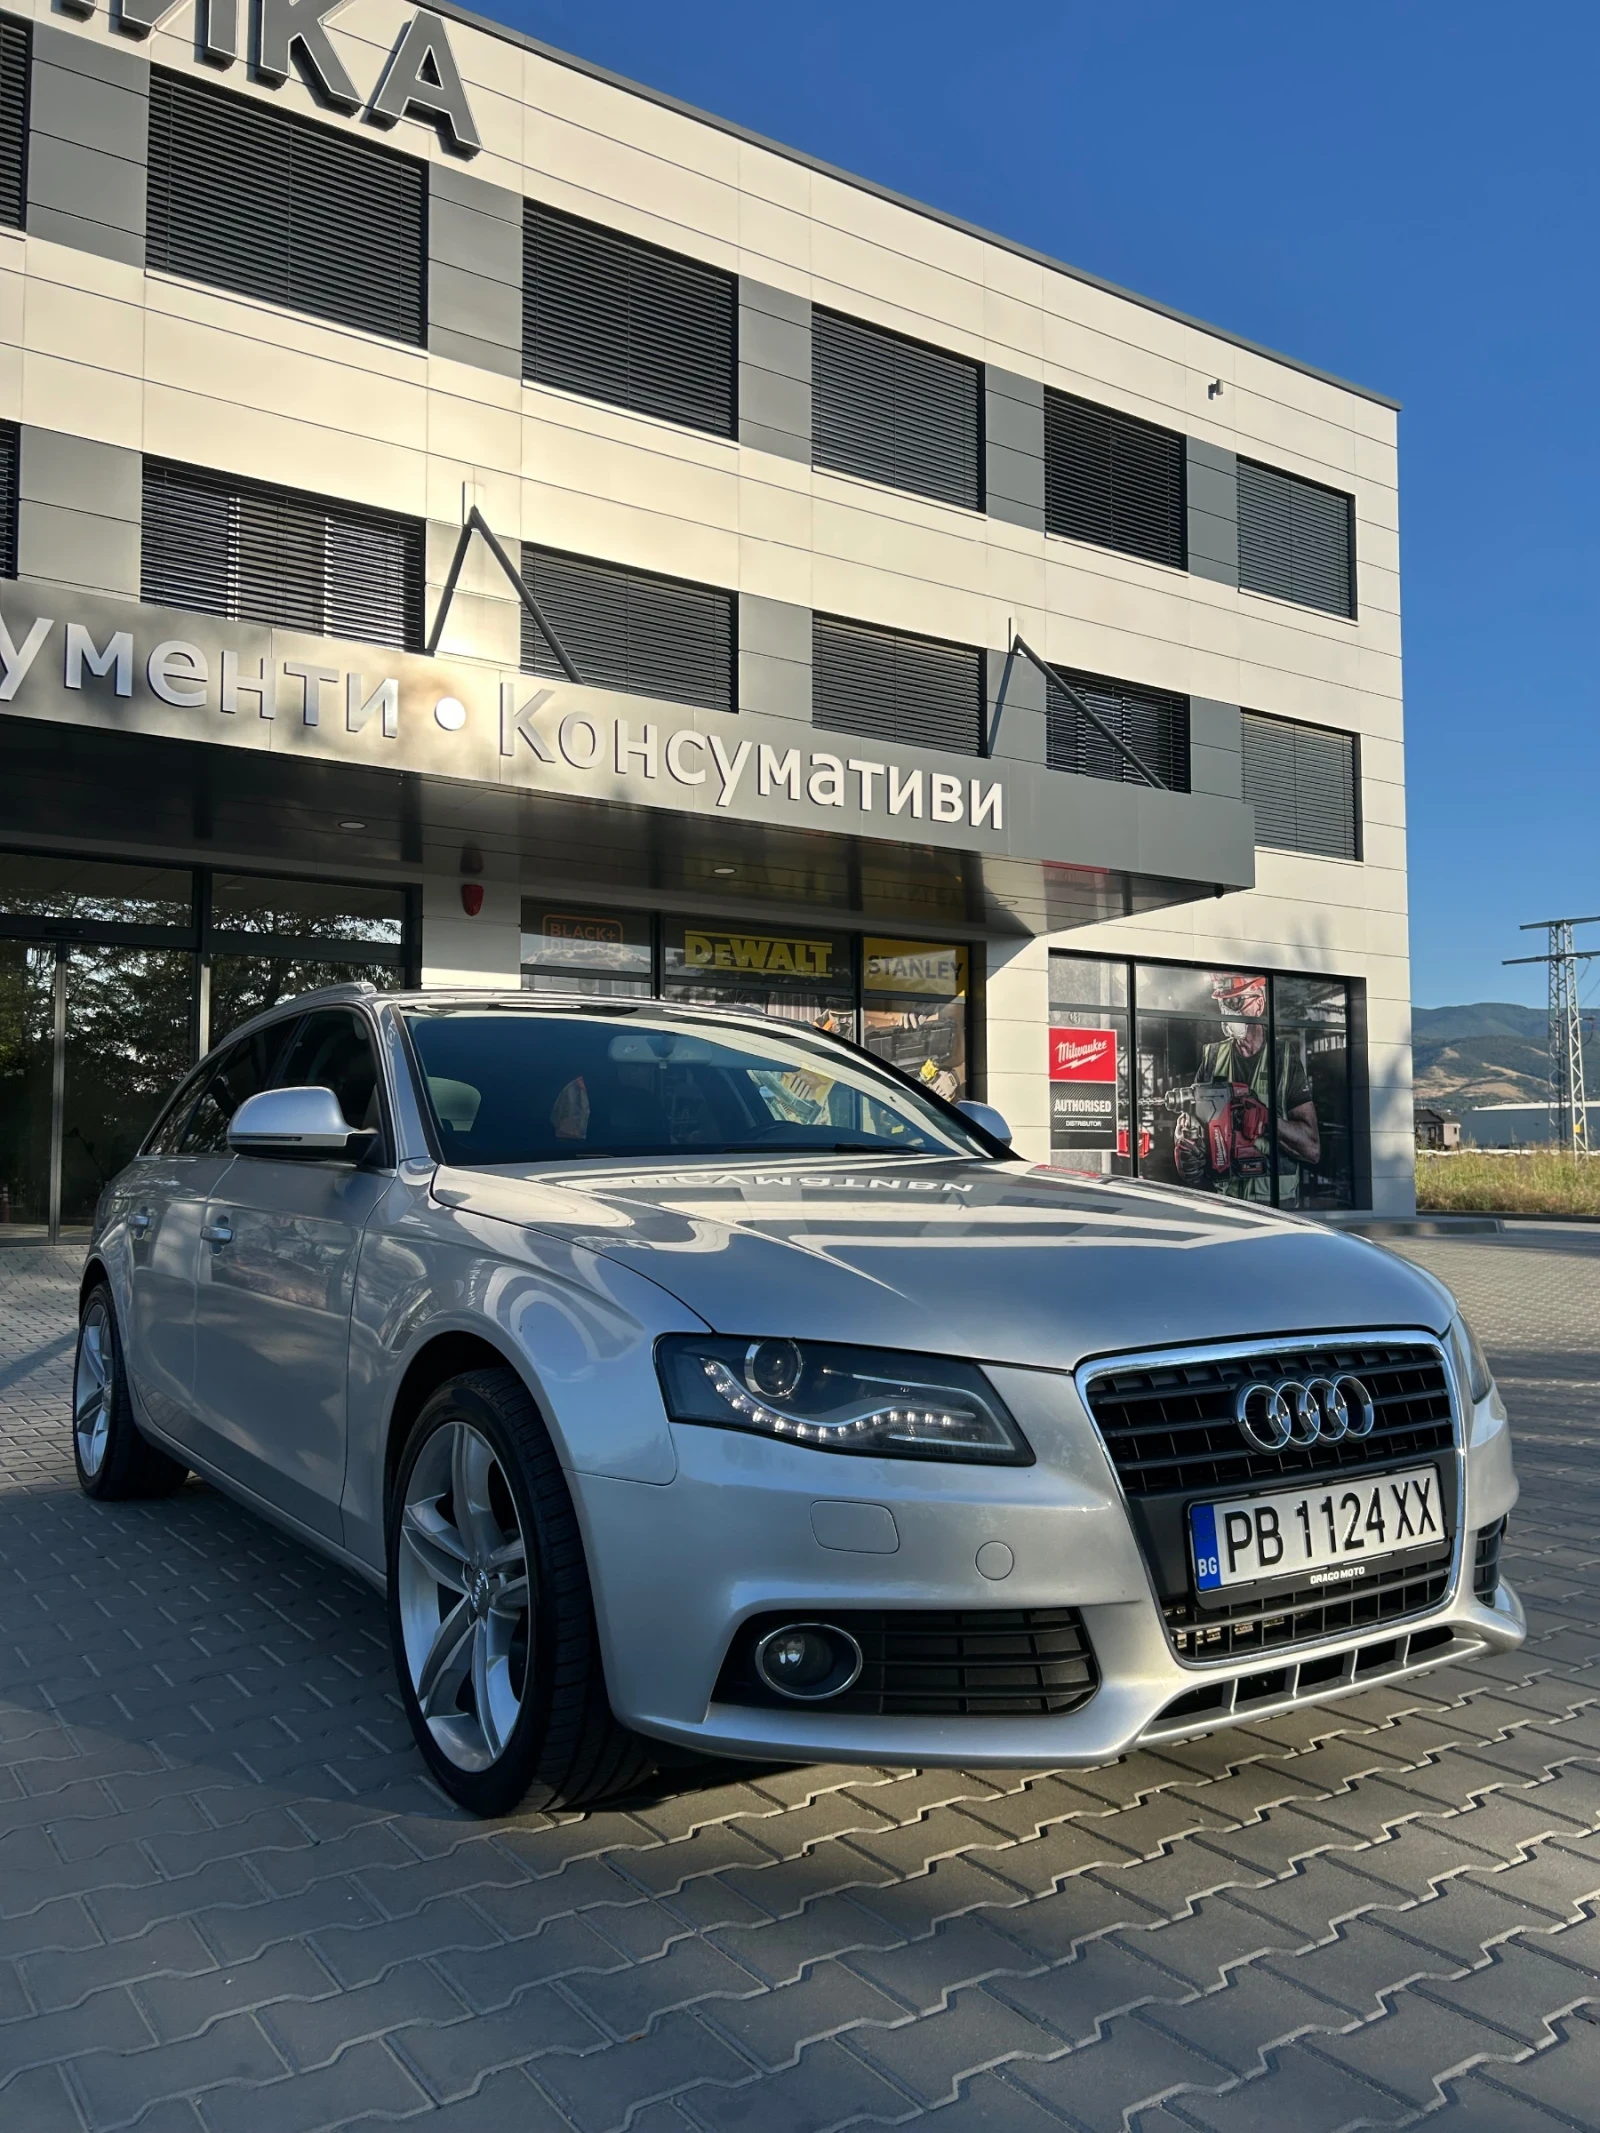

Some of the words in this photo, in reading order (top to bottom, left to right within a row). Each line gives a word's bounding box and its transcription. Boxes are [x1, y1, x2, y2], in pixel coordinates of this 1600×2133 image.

[500, 682, 1003, 830] Консумативи
[550, 923, 617, 941] BLACK+
[867, 955, 964, 981] STANLEY
[1054, 1038, 1108, 1063] Milwaukee
[1054, 1099, 1112, 1113] AUTHORISED
[1225, 1506, 1284, 1573] PB
[1294, 1487, 1386, 1558] 1124
[1390, 1478, 1437, 1540] XX
[1198, 1557, 1217, 1577] BG
[1340, 1566, 1366, 1579] MOTO
